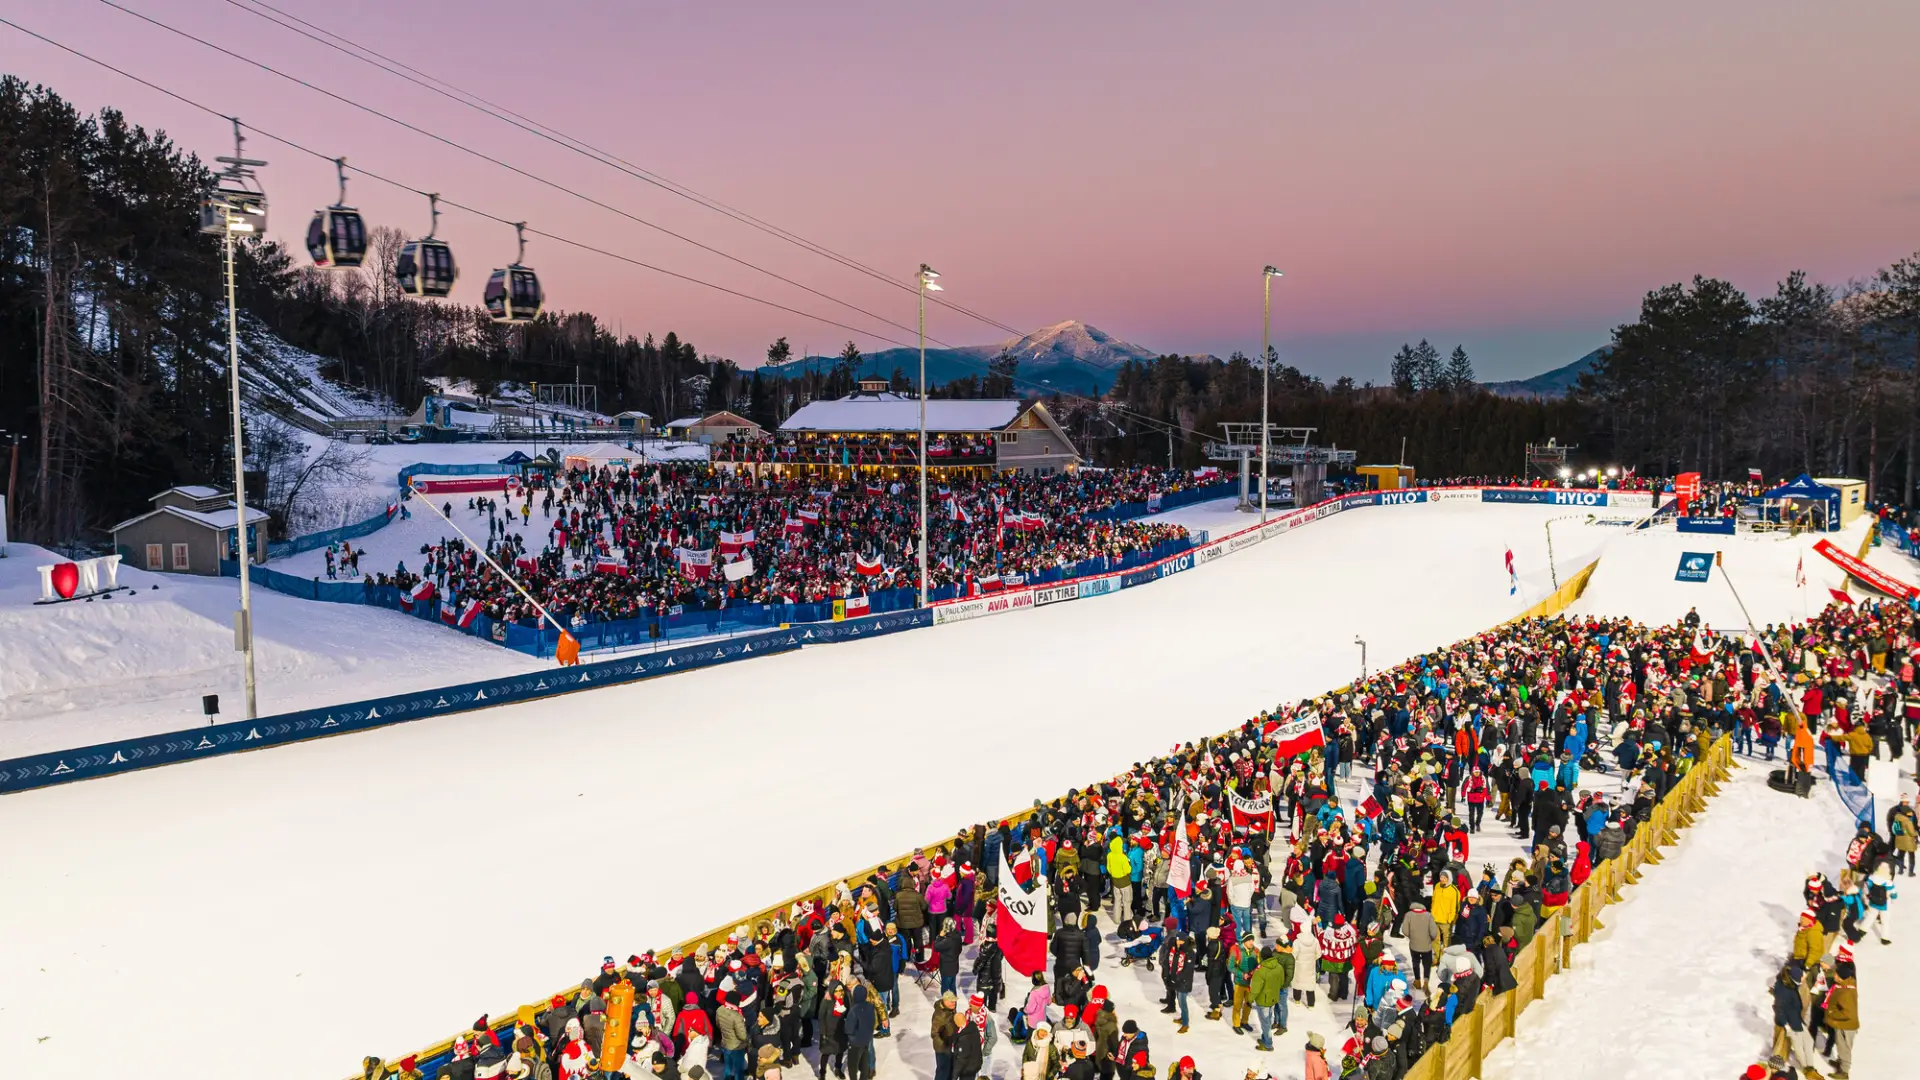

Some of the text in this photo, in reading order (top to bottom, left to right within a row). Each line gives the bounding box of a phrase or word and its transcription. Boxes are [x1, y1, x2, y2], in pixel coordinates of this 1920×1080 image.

[1207, 545, 1223, 559] RAIN
[37, 565, 56, 602] I
[1037, 586, 1076, 603] FAT TIRE
[945, 606, 960, 616] PAUL
